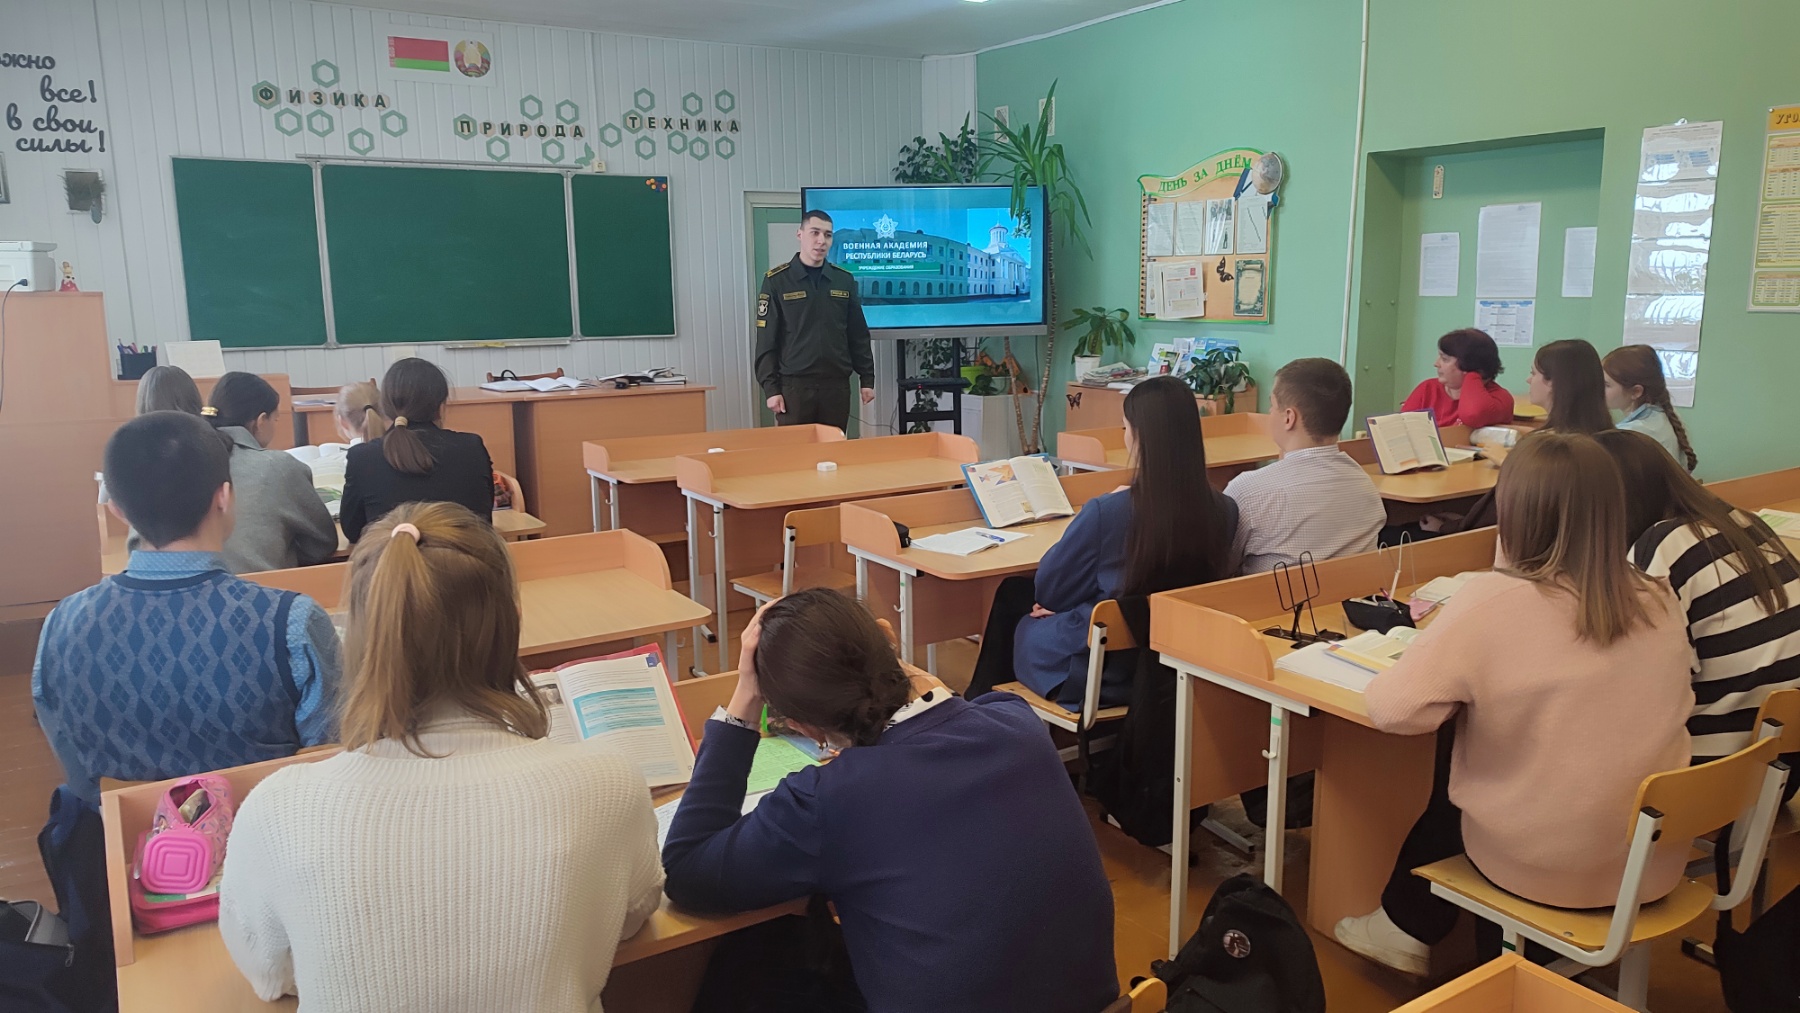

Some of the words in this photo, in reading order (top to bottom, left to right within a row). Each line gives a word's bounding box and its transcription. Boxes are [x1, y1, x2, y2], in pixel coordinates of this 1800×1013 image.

[0, 53, 56, 70] жно
[40, 74, 97, 103] все!
[259, 87, 387, 108] ФИЗИКА
[6, 103, 22, 131] в
[33, 104, 98, 134] свои
[628, 116, 740, 133] ТЕХНИКА
[1776, 113, 1800, 125] УГО
[459, 120, 584, 138] ПРИРОДА
[16, 130, 105, 153] силы!
[1158, 177, 1188, 193] ДЕНЬ
[1193, 168, 1208, 183] ЗА
[1215, 154, 1252, 175] ДНЁМ
[843, 242, 881, 250] ВОЕННАЯ
[883, 241, 928, 251] АКАДЕМИЯ
[845, 252, 891, 260] РЕСПУБЛИКИ
[892, 251, 927, 259] БЕЛАРУСЬ
